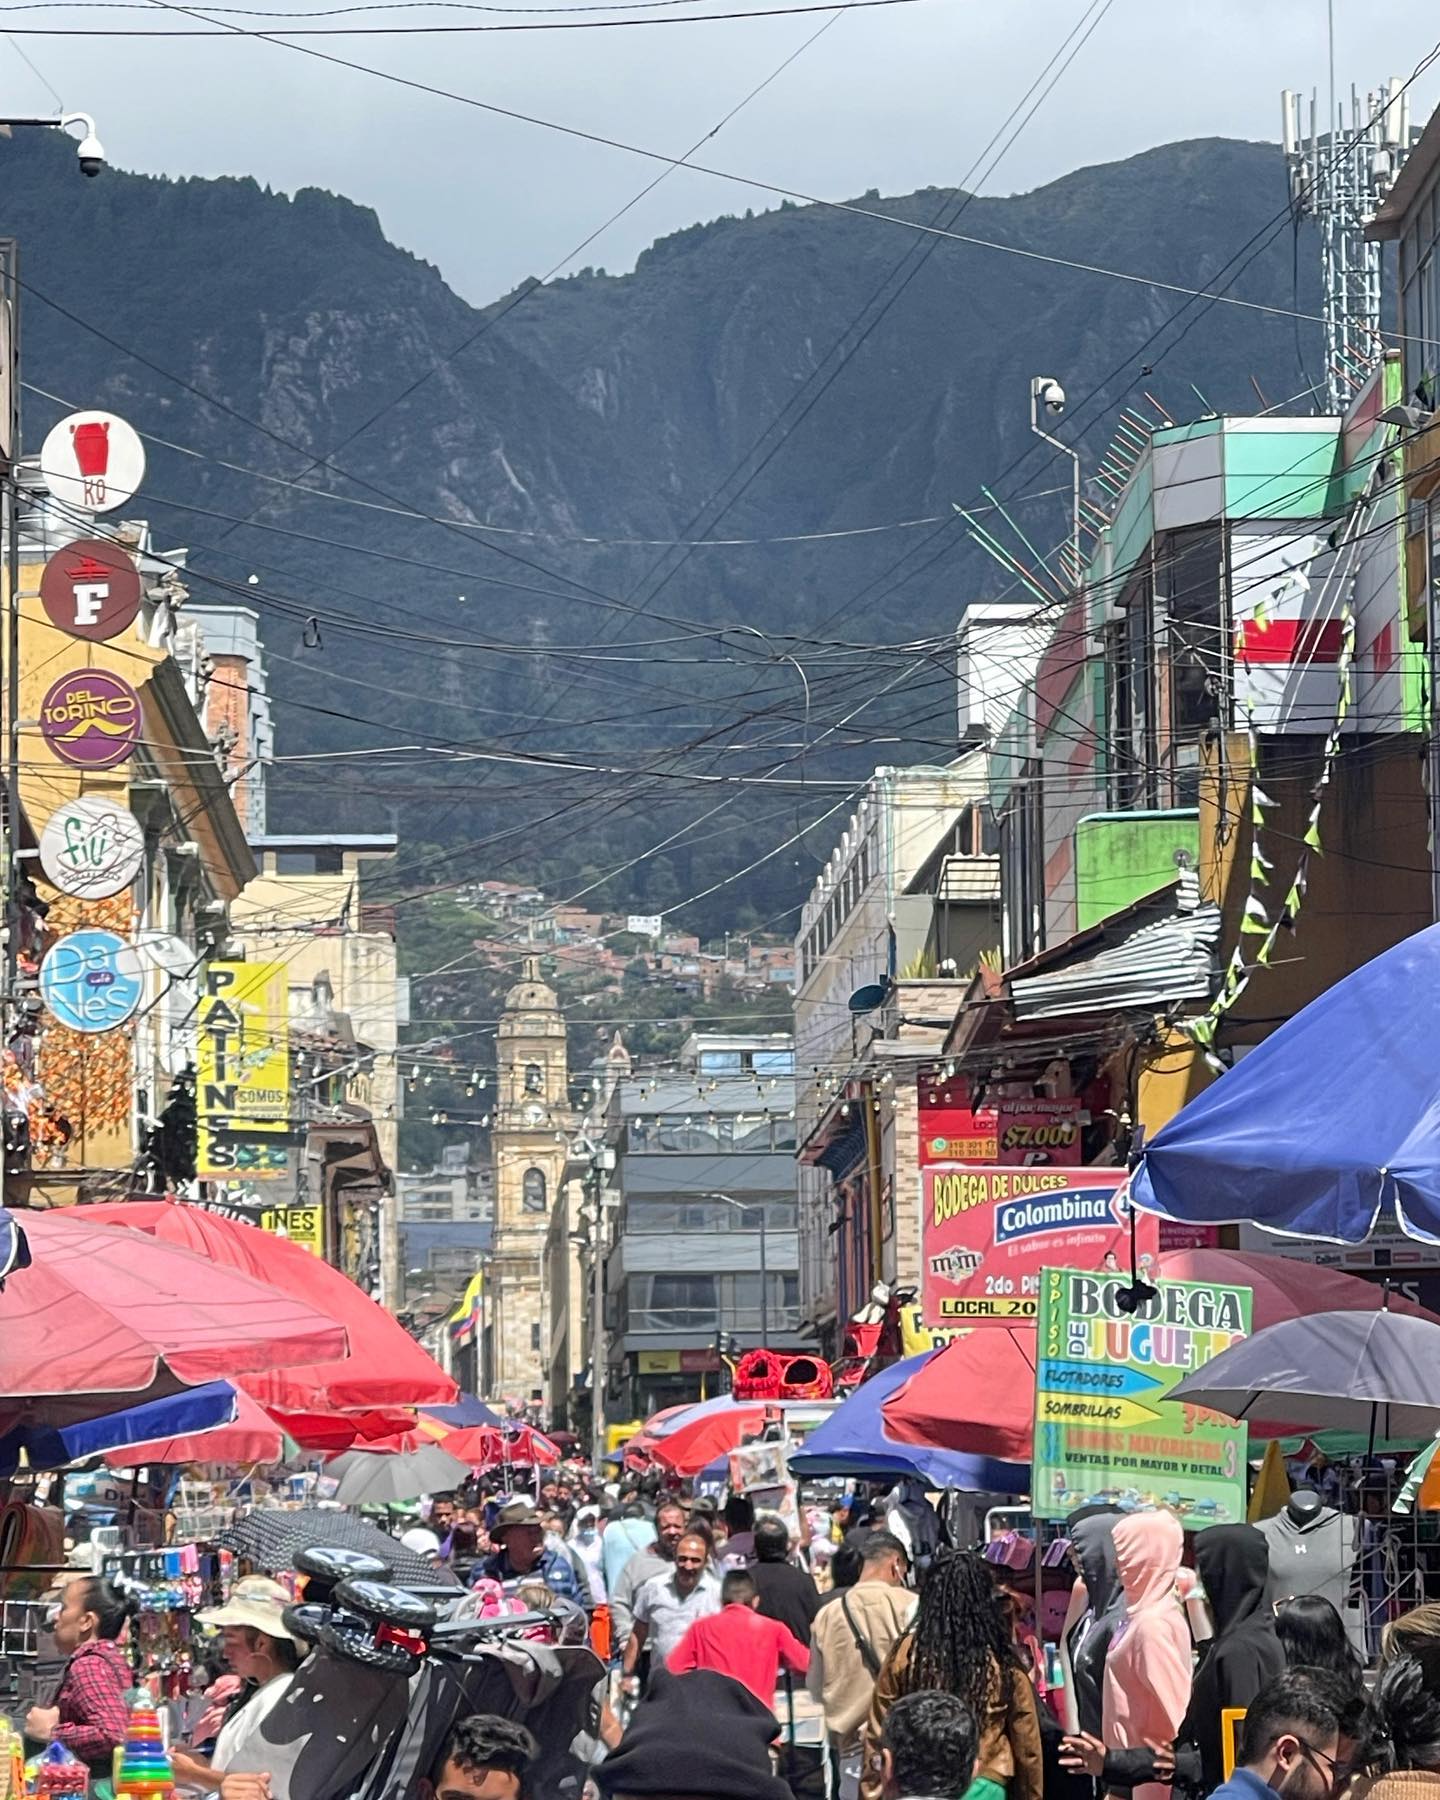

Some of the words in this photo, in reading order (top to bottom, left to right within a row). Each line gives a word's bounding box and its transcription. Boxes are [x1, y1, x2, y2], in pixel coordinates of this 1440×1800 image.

[73, 584, 109, 626] F
[44, 697, 135, 724] TORINO
[66, 690, 105, 705] DEL
[239, 1090, 283, 1103] SOMOS
[1004, 1124, 1077, 1147] $7.000
[933, 1174, 988, 1227] BODEGA
[991, 1174, 1008, 1200] DE
[1012, 1175, 1068, 1196] DULCES
[1001, 1194, 1106, 1232] Colombina
[942, 1301, 1001, 1315] LOCAL
[1070, 1277, 1244, 1331] BODEGA
[1048, 1290, 1061, 1357] PISO
[1068, 1322, 1087, 1358] DE
[1087, 1318, 1248, 1370] JUGUETE
[1045, 1370, 1124, 1389] FLOTADORES
[1044, 1400, 1122, 1419] SOMBRILLAS
[1065, 1453, 1110, 1466] VENTAS
[1113, 1456, 1138, 1467] POR
[1140, 1459, 1178, 1472] MAYOR
[1181, 1463, 1188, 1472] Y
[1190, 1463, 1224, 1476] DETAL
